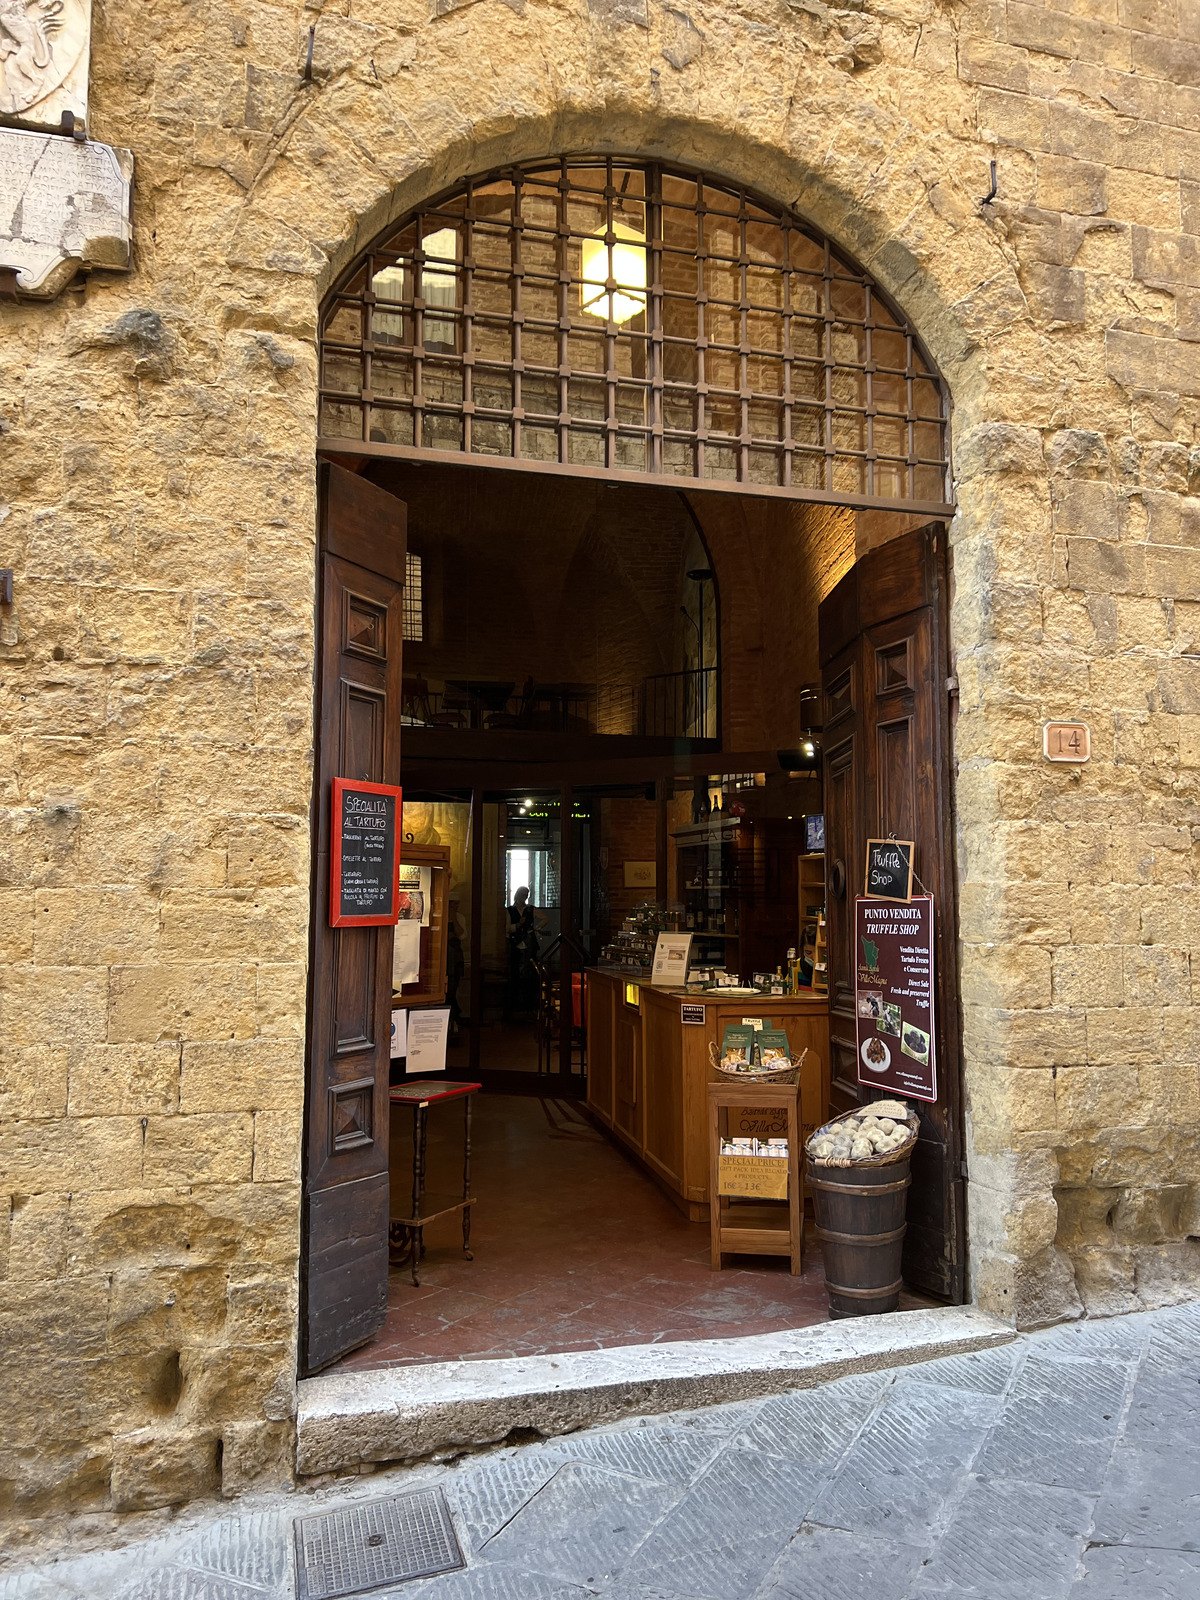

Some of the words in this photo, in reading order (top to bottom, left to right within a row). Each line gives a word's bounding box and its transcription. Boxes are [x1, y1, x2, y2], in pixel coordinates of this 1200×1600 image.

[1057, 730, 1081, 755] 14
[343, 816, 354, 827] AL
[353, 816, 386, 828] TARTUFO
[873, 849, 901, 868] Truffle
[870, 869, 893, 886] Shop
[864, 908, 889, 919] PUNTO
[889, 908, 922, 920] VENDITA
[866, 924, 899, 935] TRUFFLE
[899, 924, 920, 936] SHOP
[899, 945, 915, 953] Vendita
[914, 946, 929, 954] Diretta
[900, 955, 915, 964] Tartufo
[915, 956, 929, 964] Fresco
[906, 965, 929, 974] Conservato
[908, 978, 921, 986] Direct
[920, 979, 930, 988] Sale
[890, 986, 902, 994] Fresh
[722, 1157, 755, 1166] SPECIAL
[757, 1158, 785, 1167] PRICE!
[744, 1182, 761, 1191] 13€
